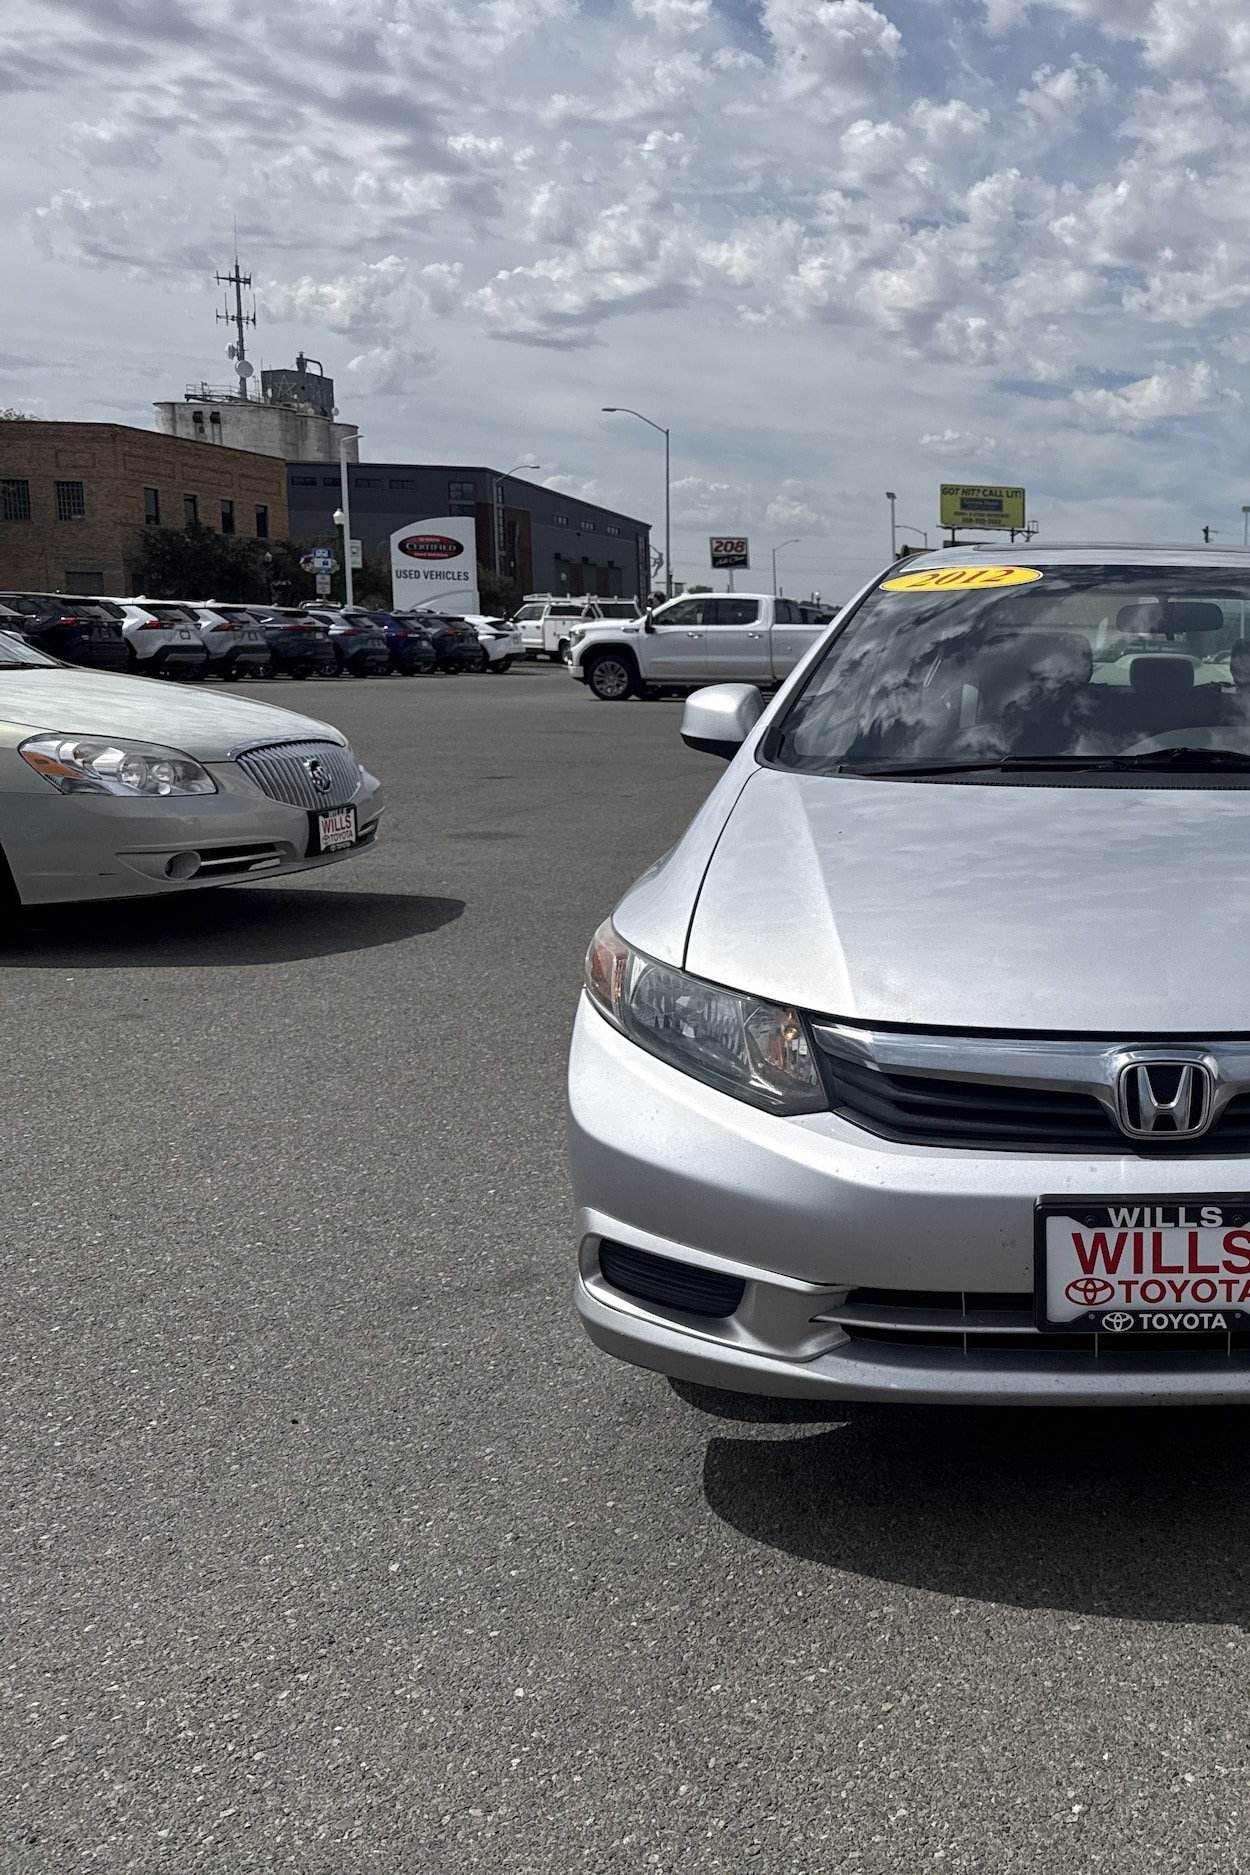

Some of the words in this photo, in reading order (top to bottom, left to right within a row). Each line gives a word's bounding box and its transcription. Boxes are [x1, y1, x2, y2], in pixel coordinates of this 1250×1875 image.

[942, 487, 959, 496] GOT
[962, 488, 981, 497] HIT?
[982, 489, 1005, 498] CALL
[714, 540, 745, 553] 208
[395, 569, 420, 580] USED
[423, 570, 470, 581] VEHICLES
[906, 569, 1015, 588] 2012
[321, 814, 352, 834] WILLS
[330, 830, 353, 842] TOYOTA
[1107, 1206, 1223, 1228] WILLS
[1139, 1313, 1228, 1329] TOYOTA
